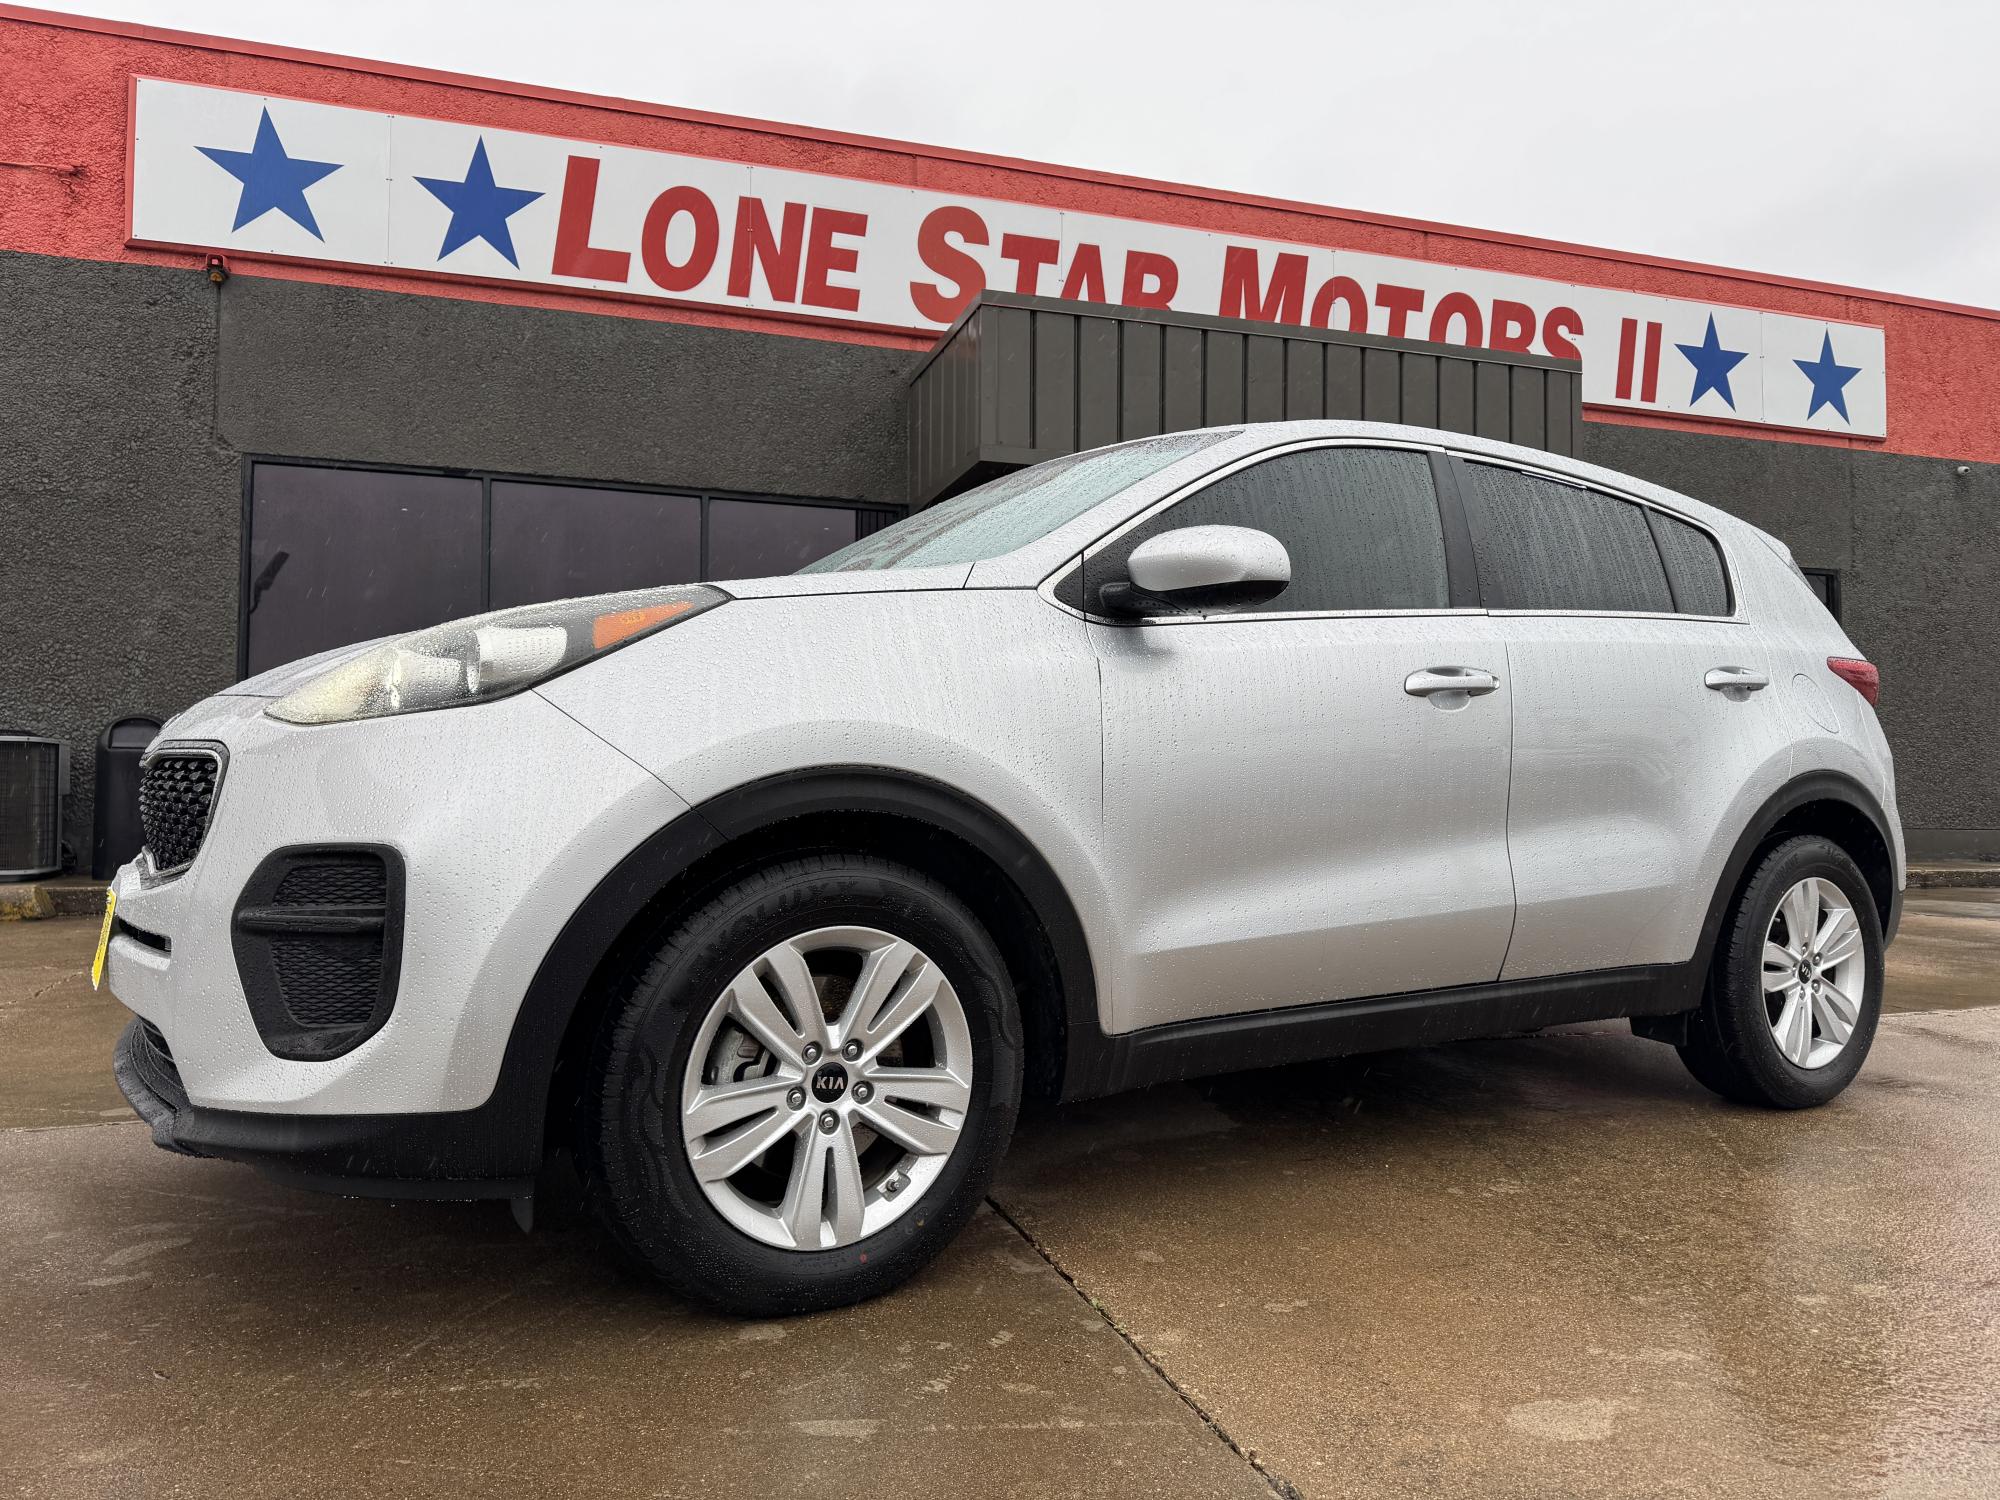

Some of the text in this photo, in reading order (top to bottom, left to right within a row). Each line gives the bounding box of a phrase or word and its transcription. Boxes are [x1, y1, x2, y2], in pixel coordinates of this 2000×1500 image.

[552, 155, 1663, 403] LONE STAR MOTORS II
[815, 1076, 845, 1090] KIA
